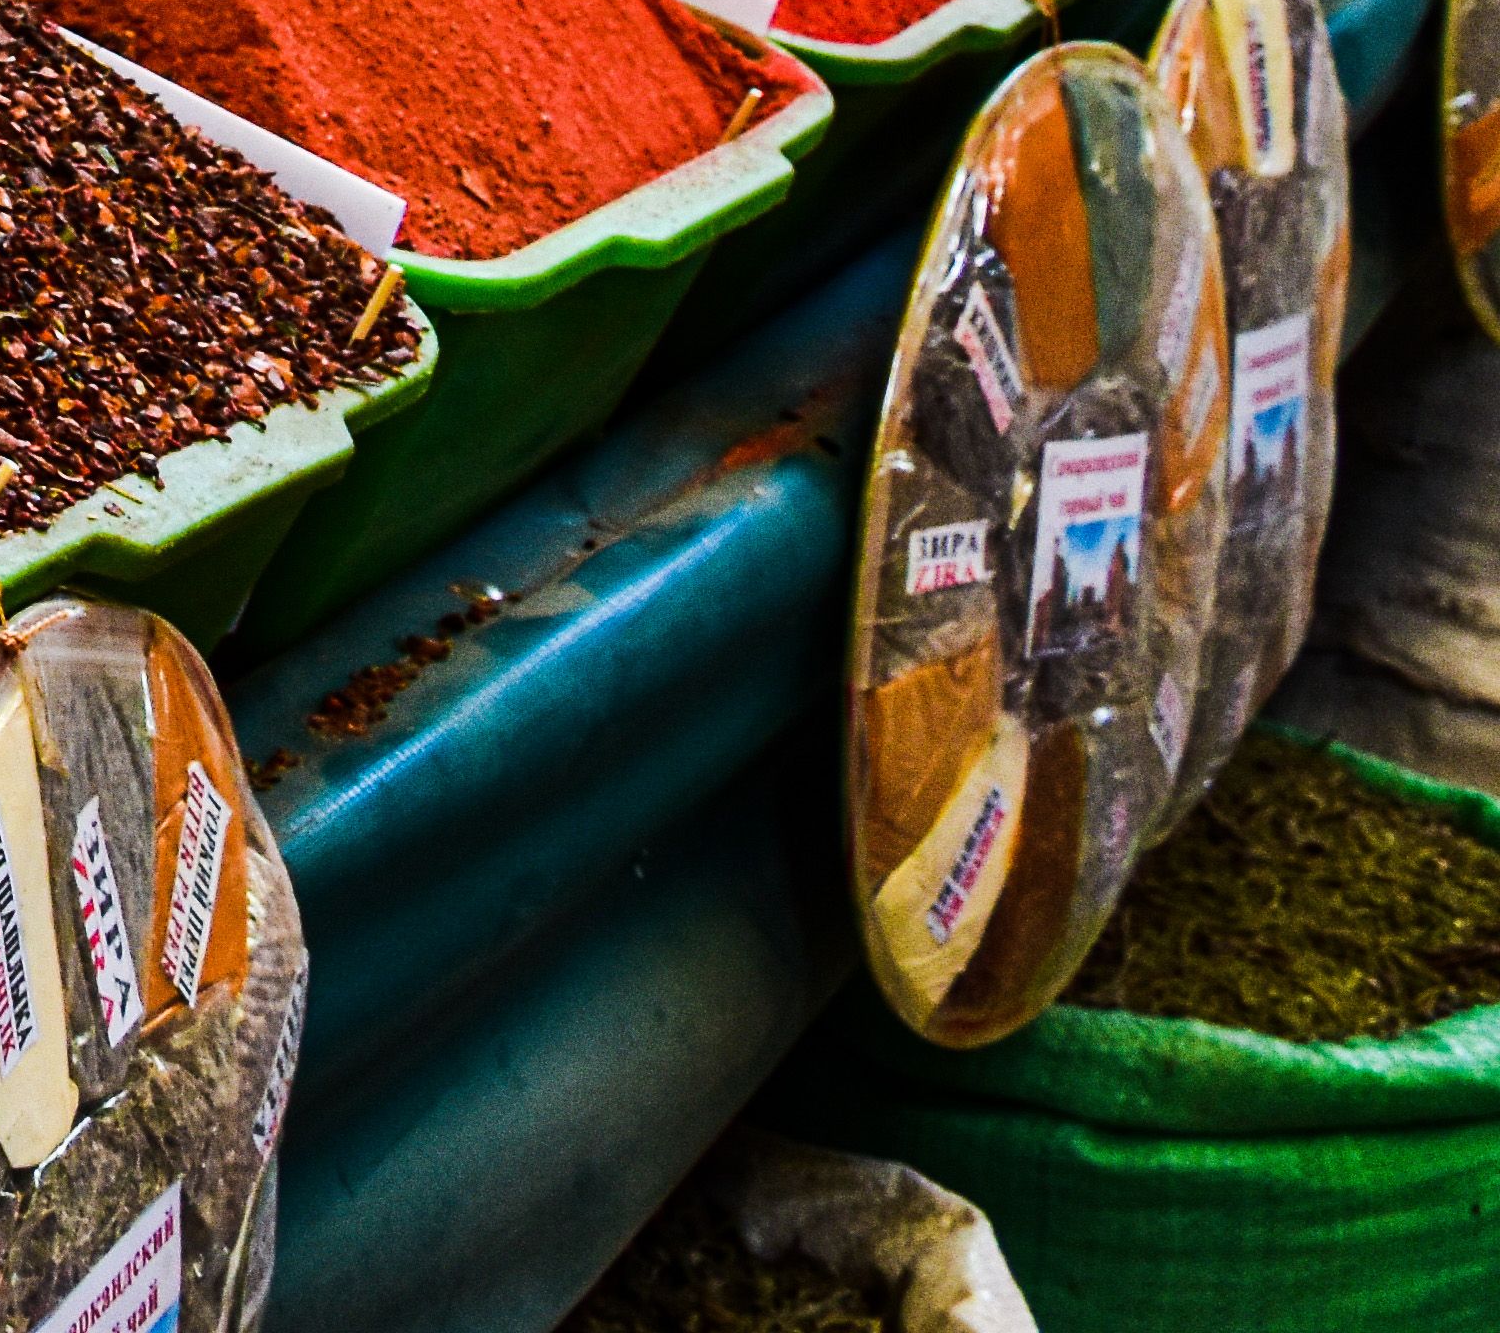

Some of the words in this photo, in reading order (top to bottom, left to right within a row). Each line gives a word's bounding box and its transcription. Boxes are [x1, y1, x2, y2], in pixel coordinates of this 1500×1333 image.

[192, 792, 222, 912] ГОРКИЙ
[85, 821, 130, 1018] ЗИРА
[127, 1278, 158, 1332] чай
